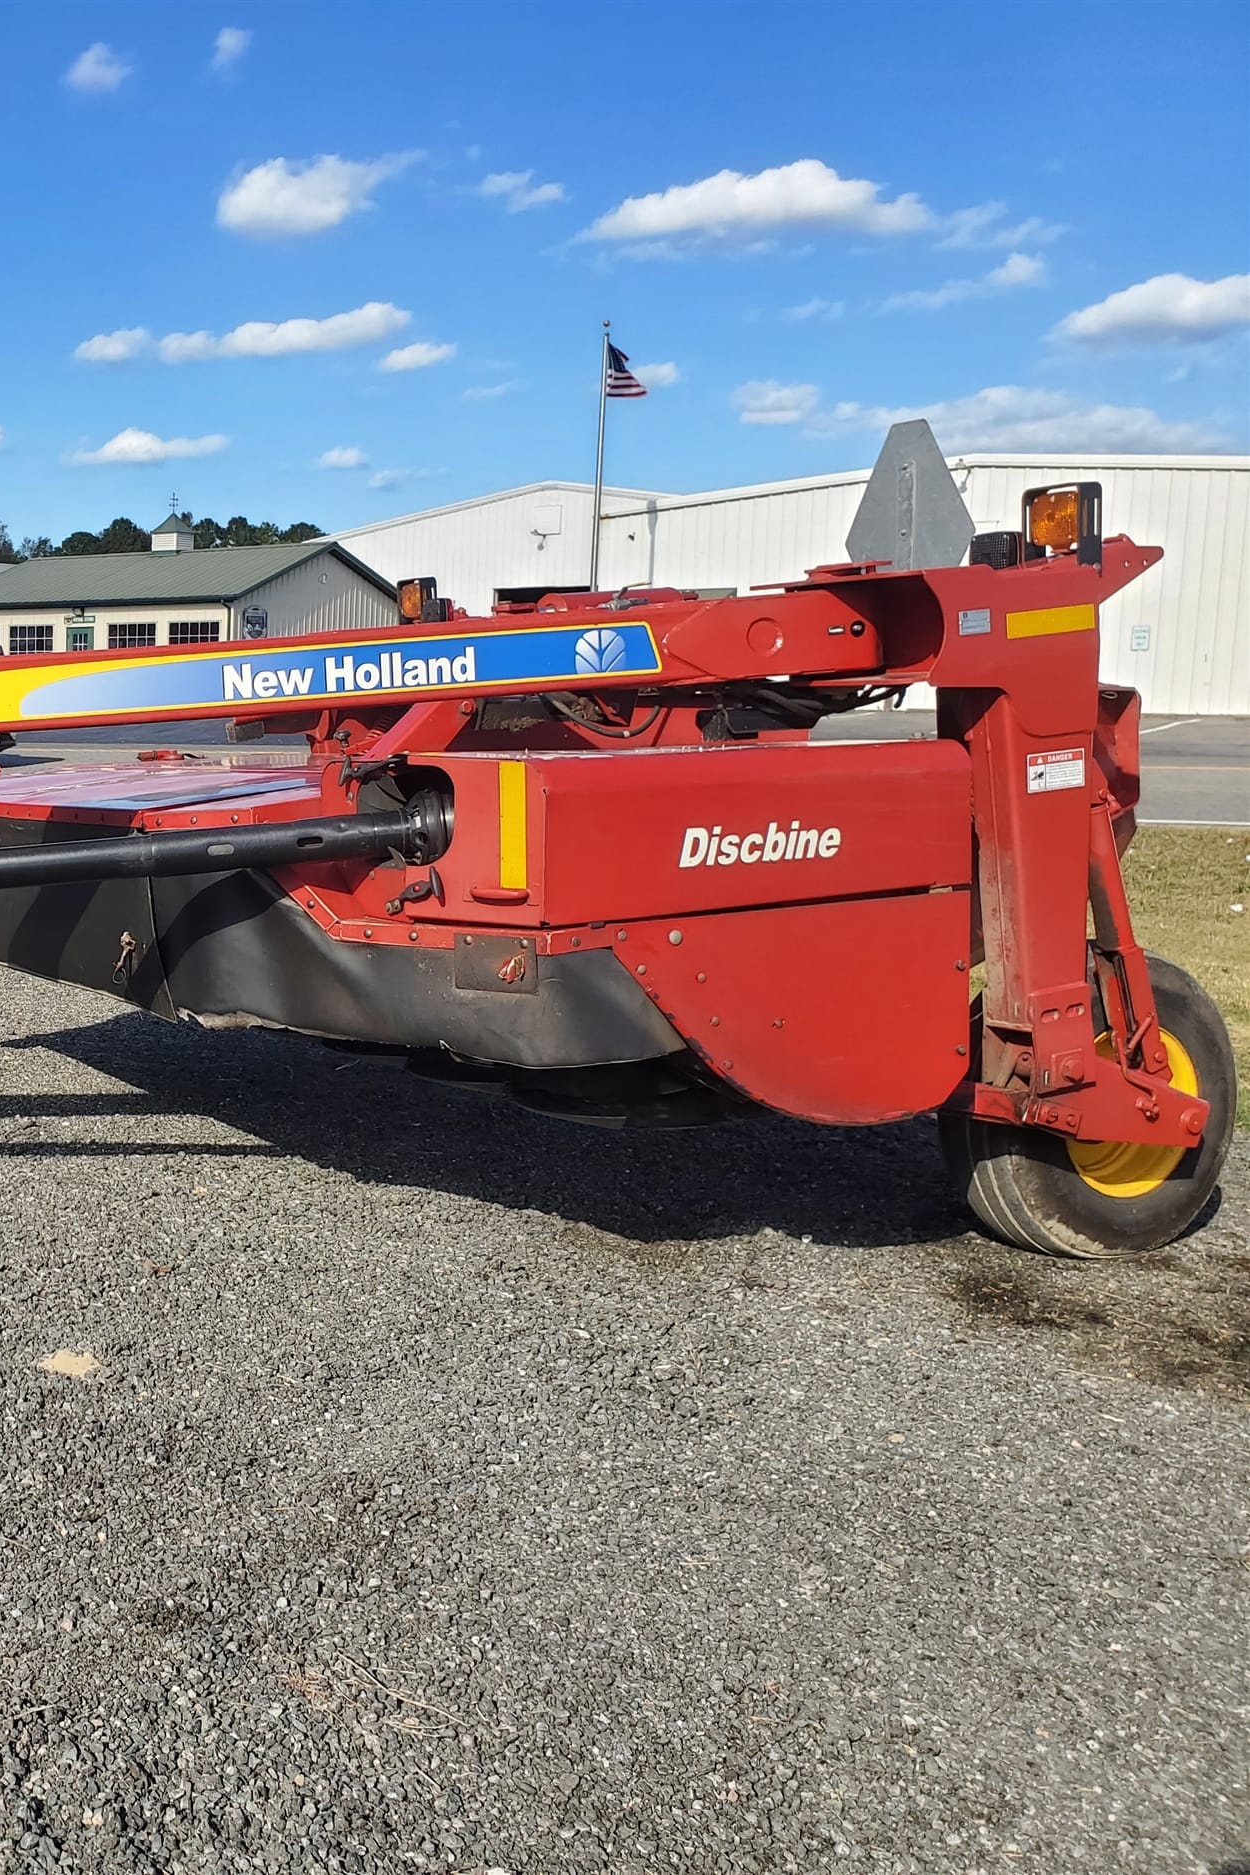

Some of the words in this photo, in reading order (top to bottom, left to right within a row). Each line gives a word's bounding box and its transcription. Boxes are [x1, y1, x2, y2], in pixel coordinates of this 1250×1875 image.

[222, 663, 314, 700] New
[324, 646, 477, 693] Holland
[1047, 753, 1073, 762] DANGER
[678, 820, 842, 869] Discbine
